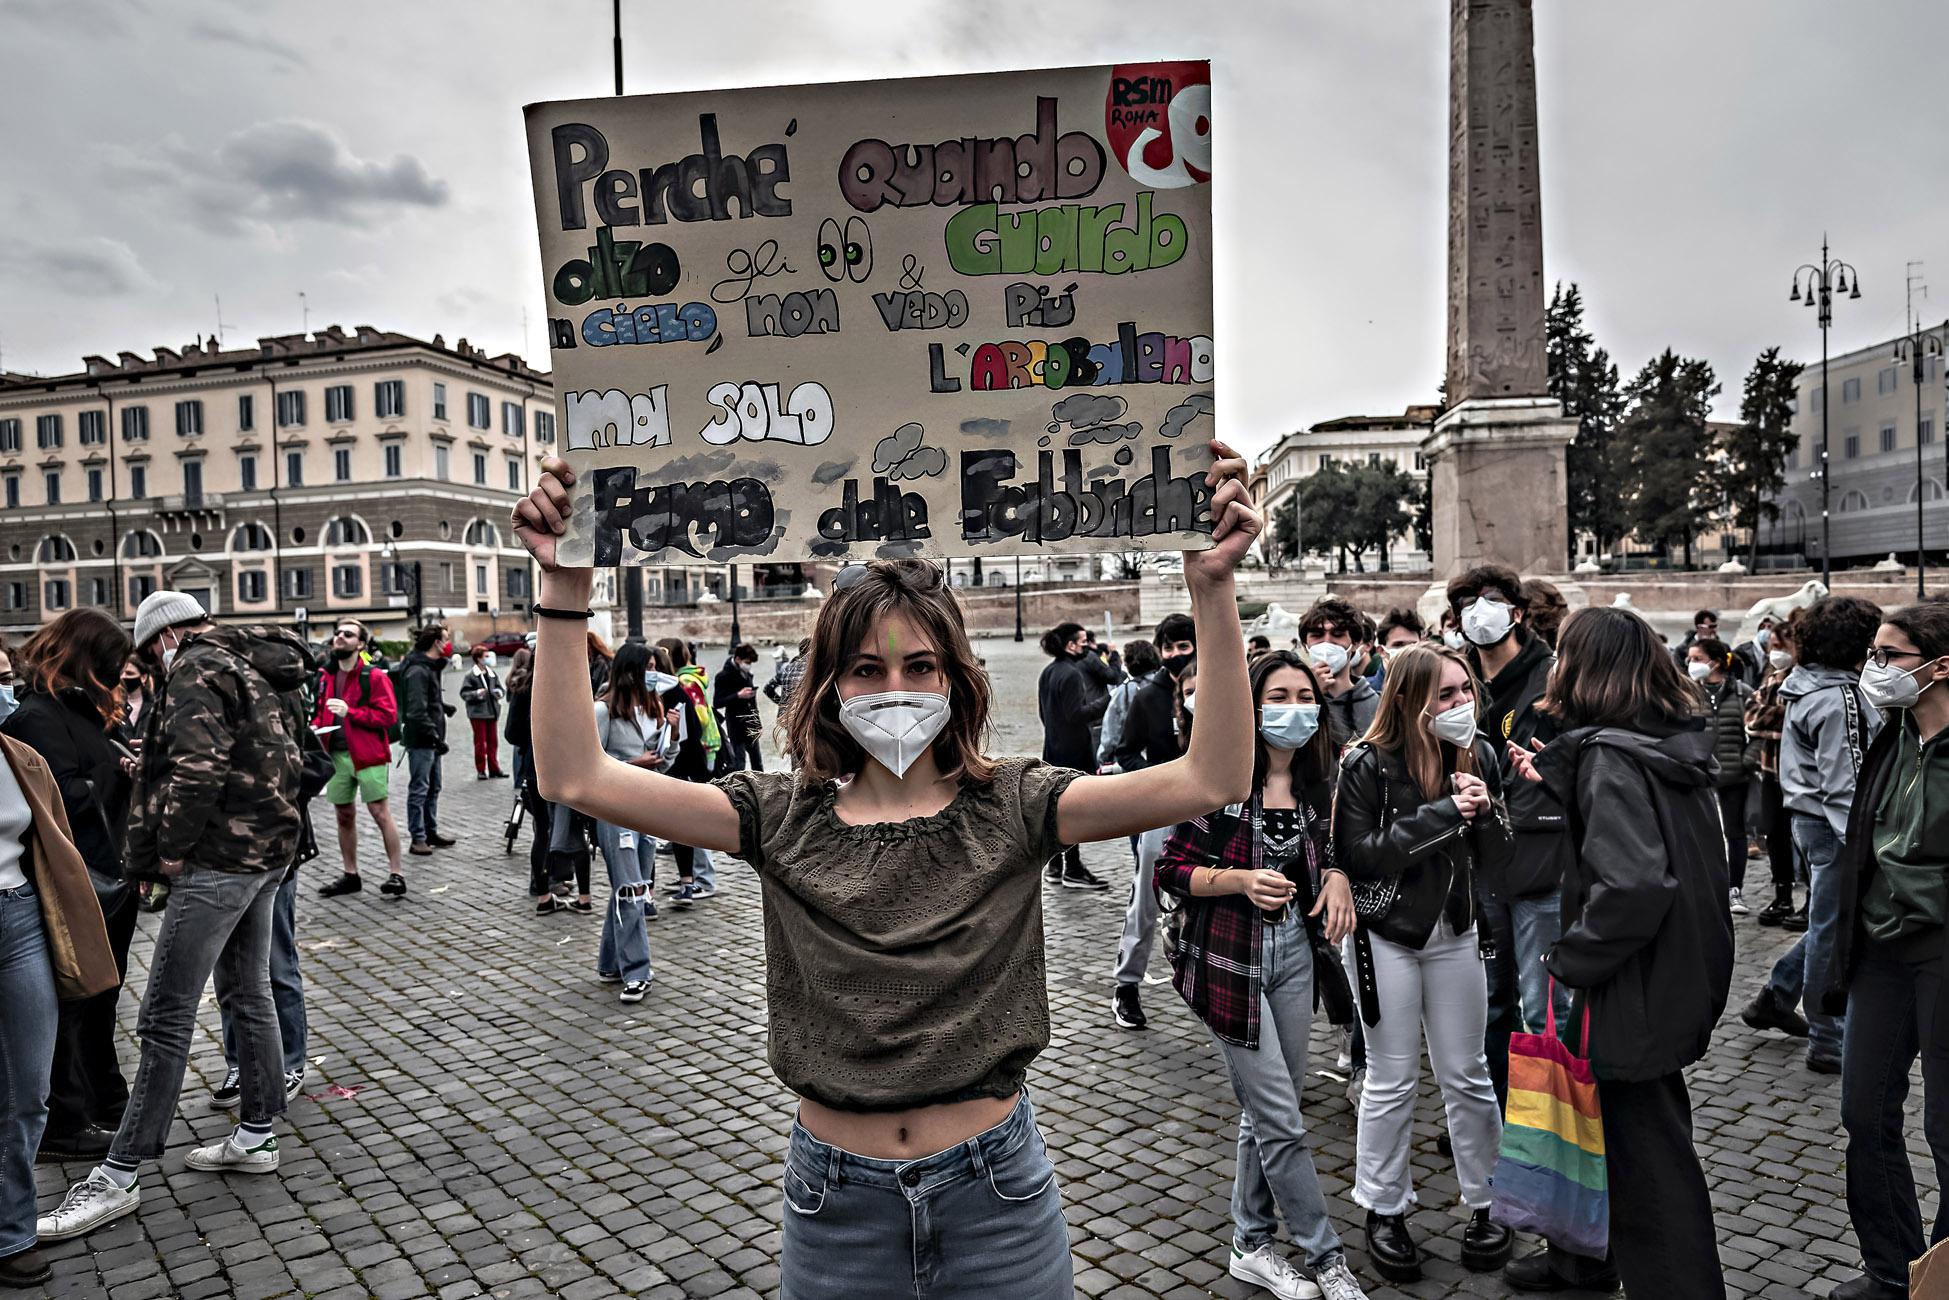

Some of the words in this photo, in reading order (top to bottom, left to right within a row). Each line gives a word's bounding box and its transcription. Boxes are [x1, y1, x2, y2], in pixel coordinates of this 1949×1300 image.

[1112, 76, 1172, 106] RSM
[1112, 108, 1160, 129] ROMA
[551, 112, 797, 231] Perché
[838, 95, 1107, 213] Quando
[553, 226, 681, 306] alzo
[710, 239, 798, 303] gli
[899, 254, 924, 289] &
[945, 191, 1188, 276] Guardo
[745, 288, 840, 337] non
[565, 384, 672, 452] ma
[699, 381, 834, 446] SOLO
[593, 466, 775, 567] Fumo
[817, 476, 932, 542] delle
[961, 445, 1216, 547] Fabbriche
